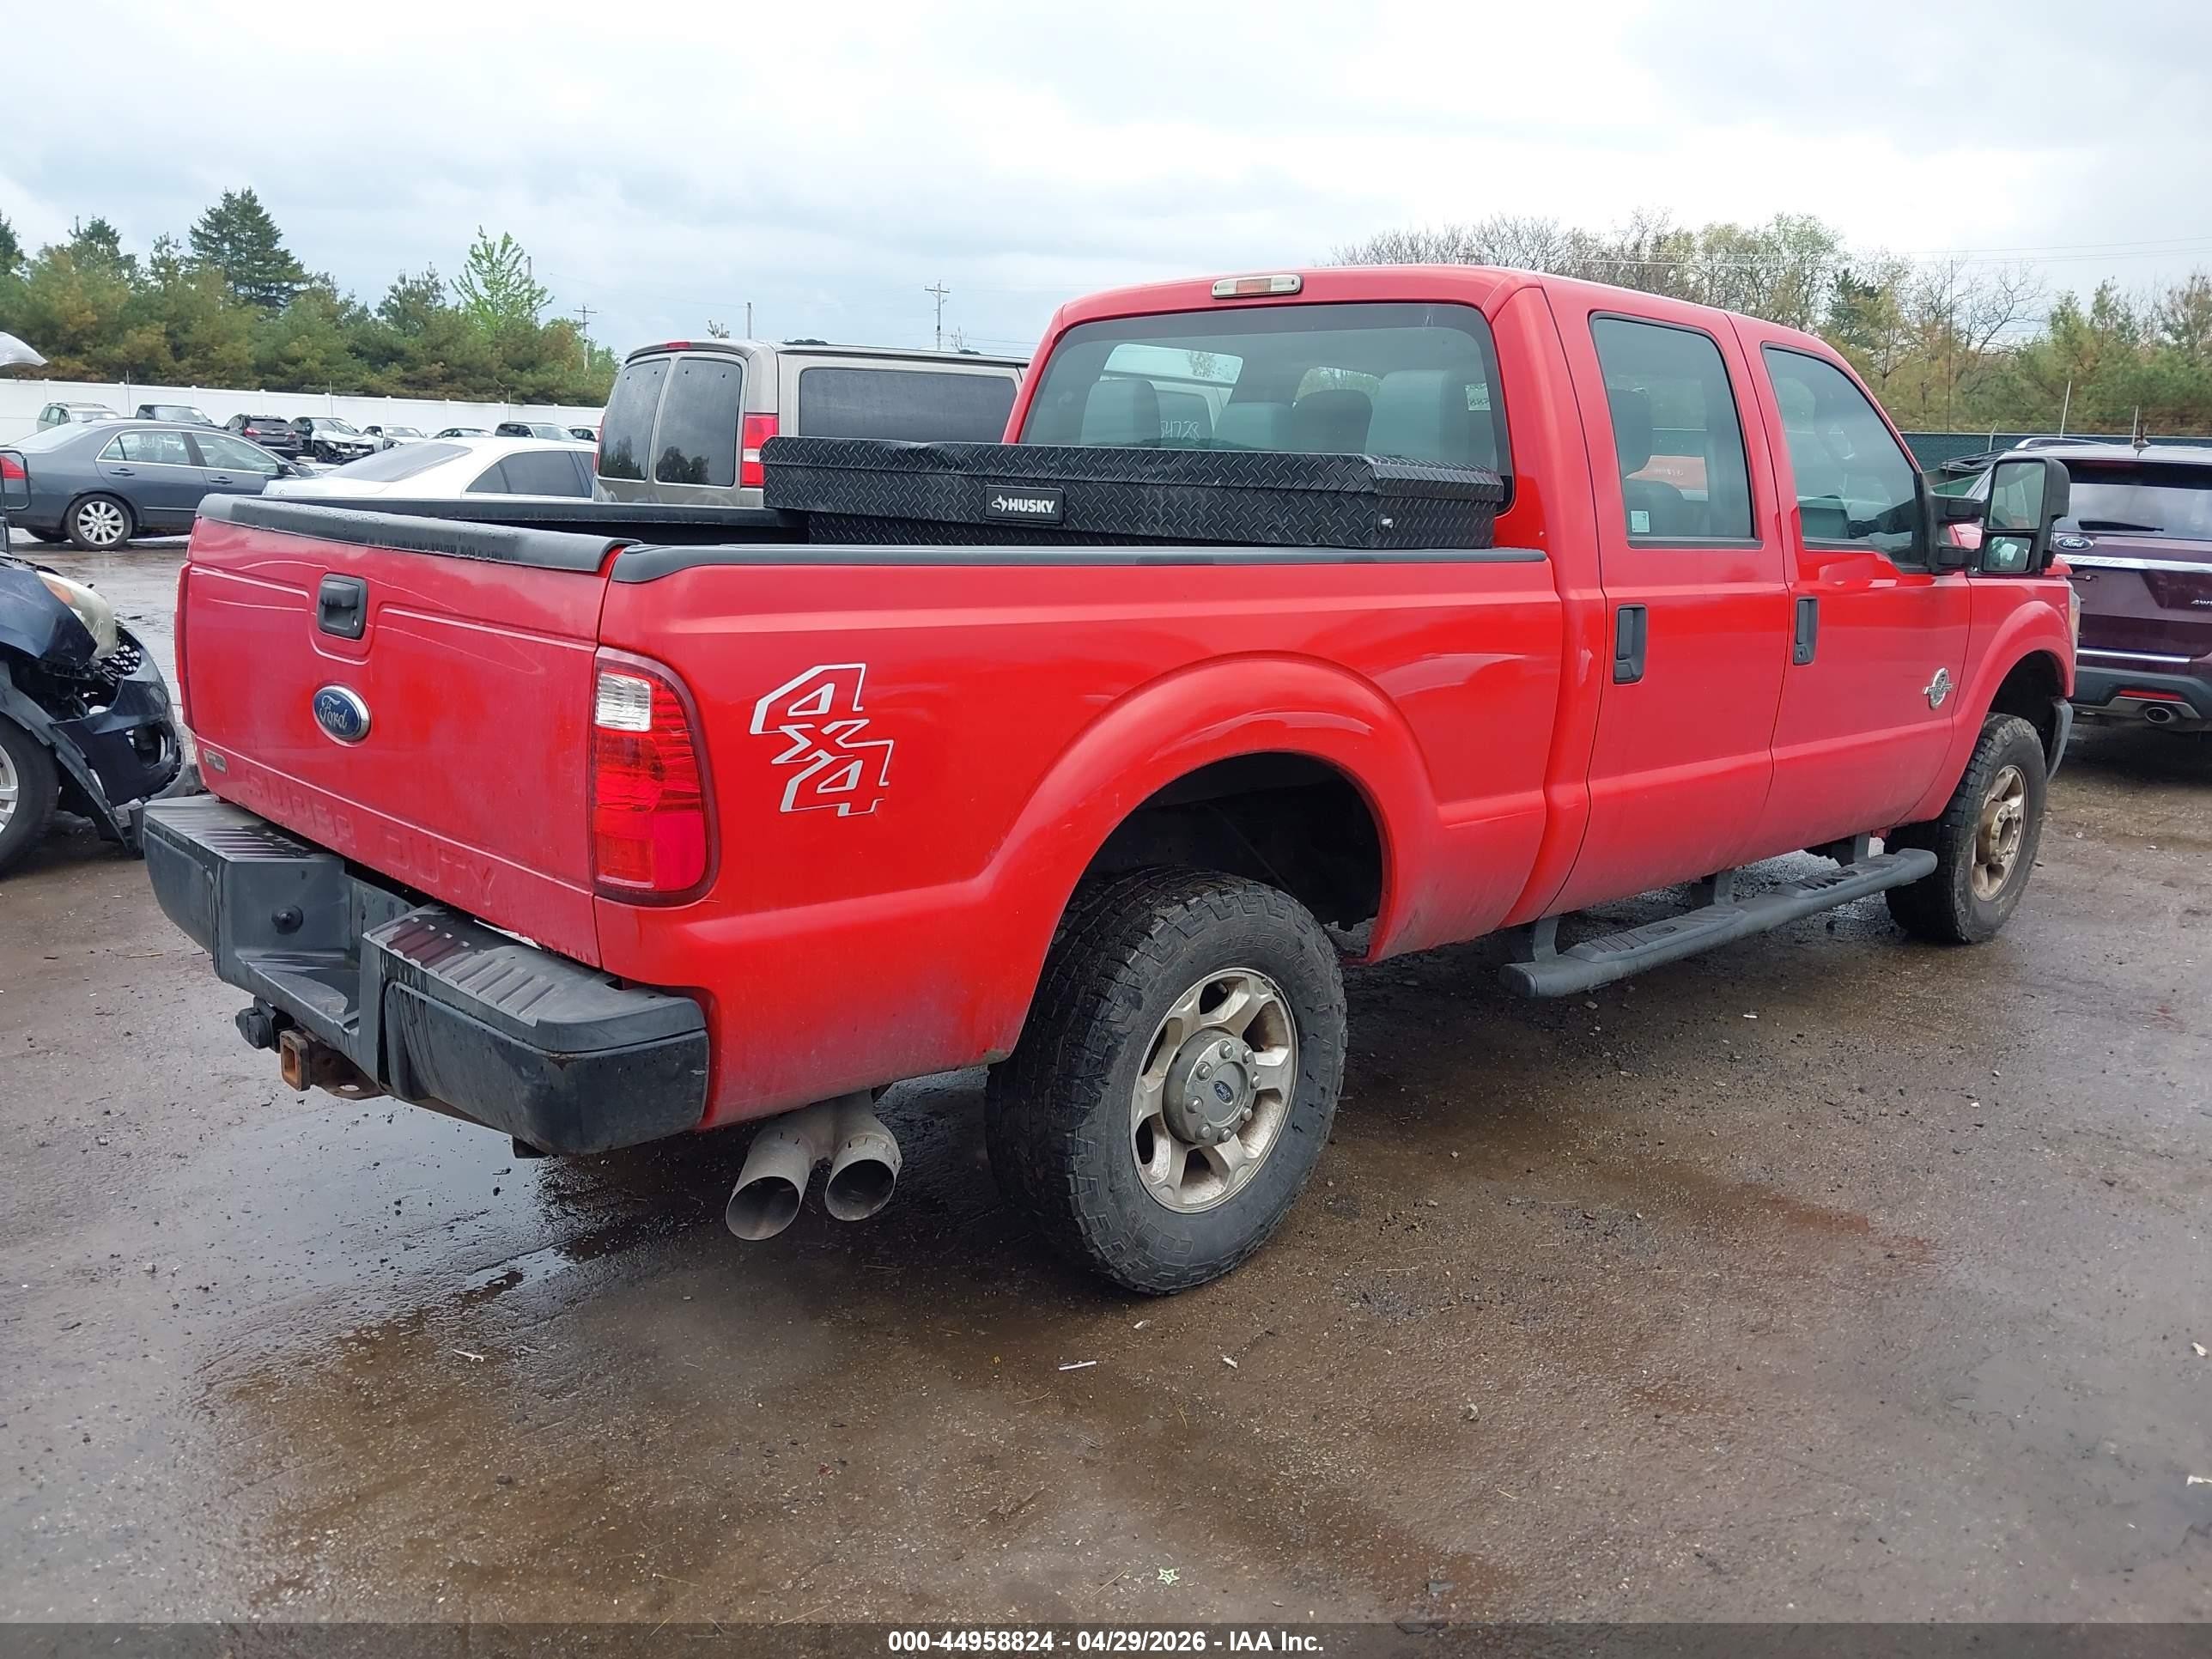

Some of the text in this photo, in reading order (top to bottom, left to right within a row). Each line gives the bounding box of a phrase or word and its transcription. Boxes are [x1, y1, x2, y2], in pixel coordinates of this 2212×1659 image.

[1007, 497, 1055, 514] HUSKY
[2062, 538, 2085, 549] Ford
[319, 694, 349, 731] Ford
[244, 767, 496, 907] SUPER DUTY
